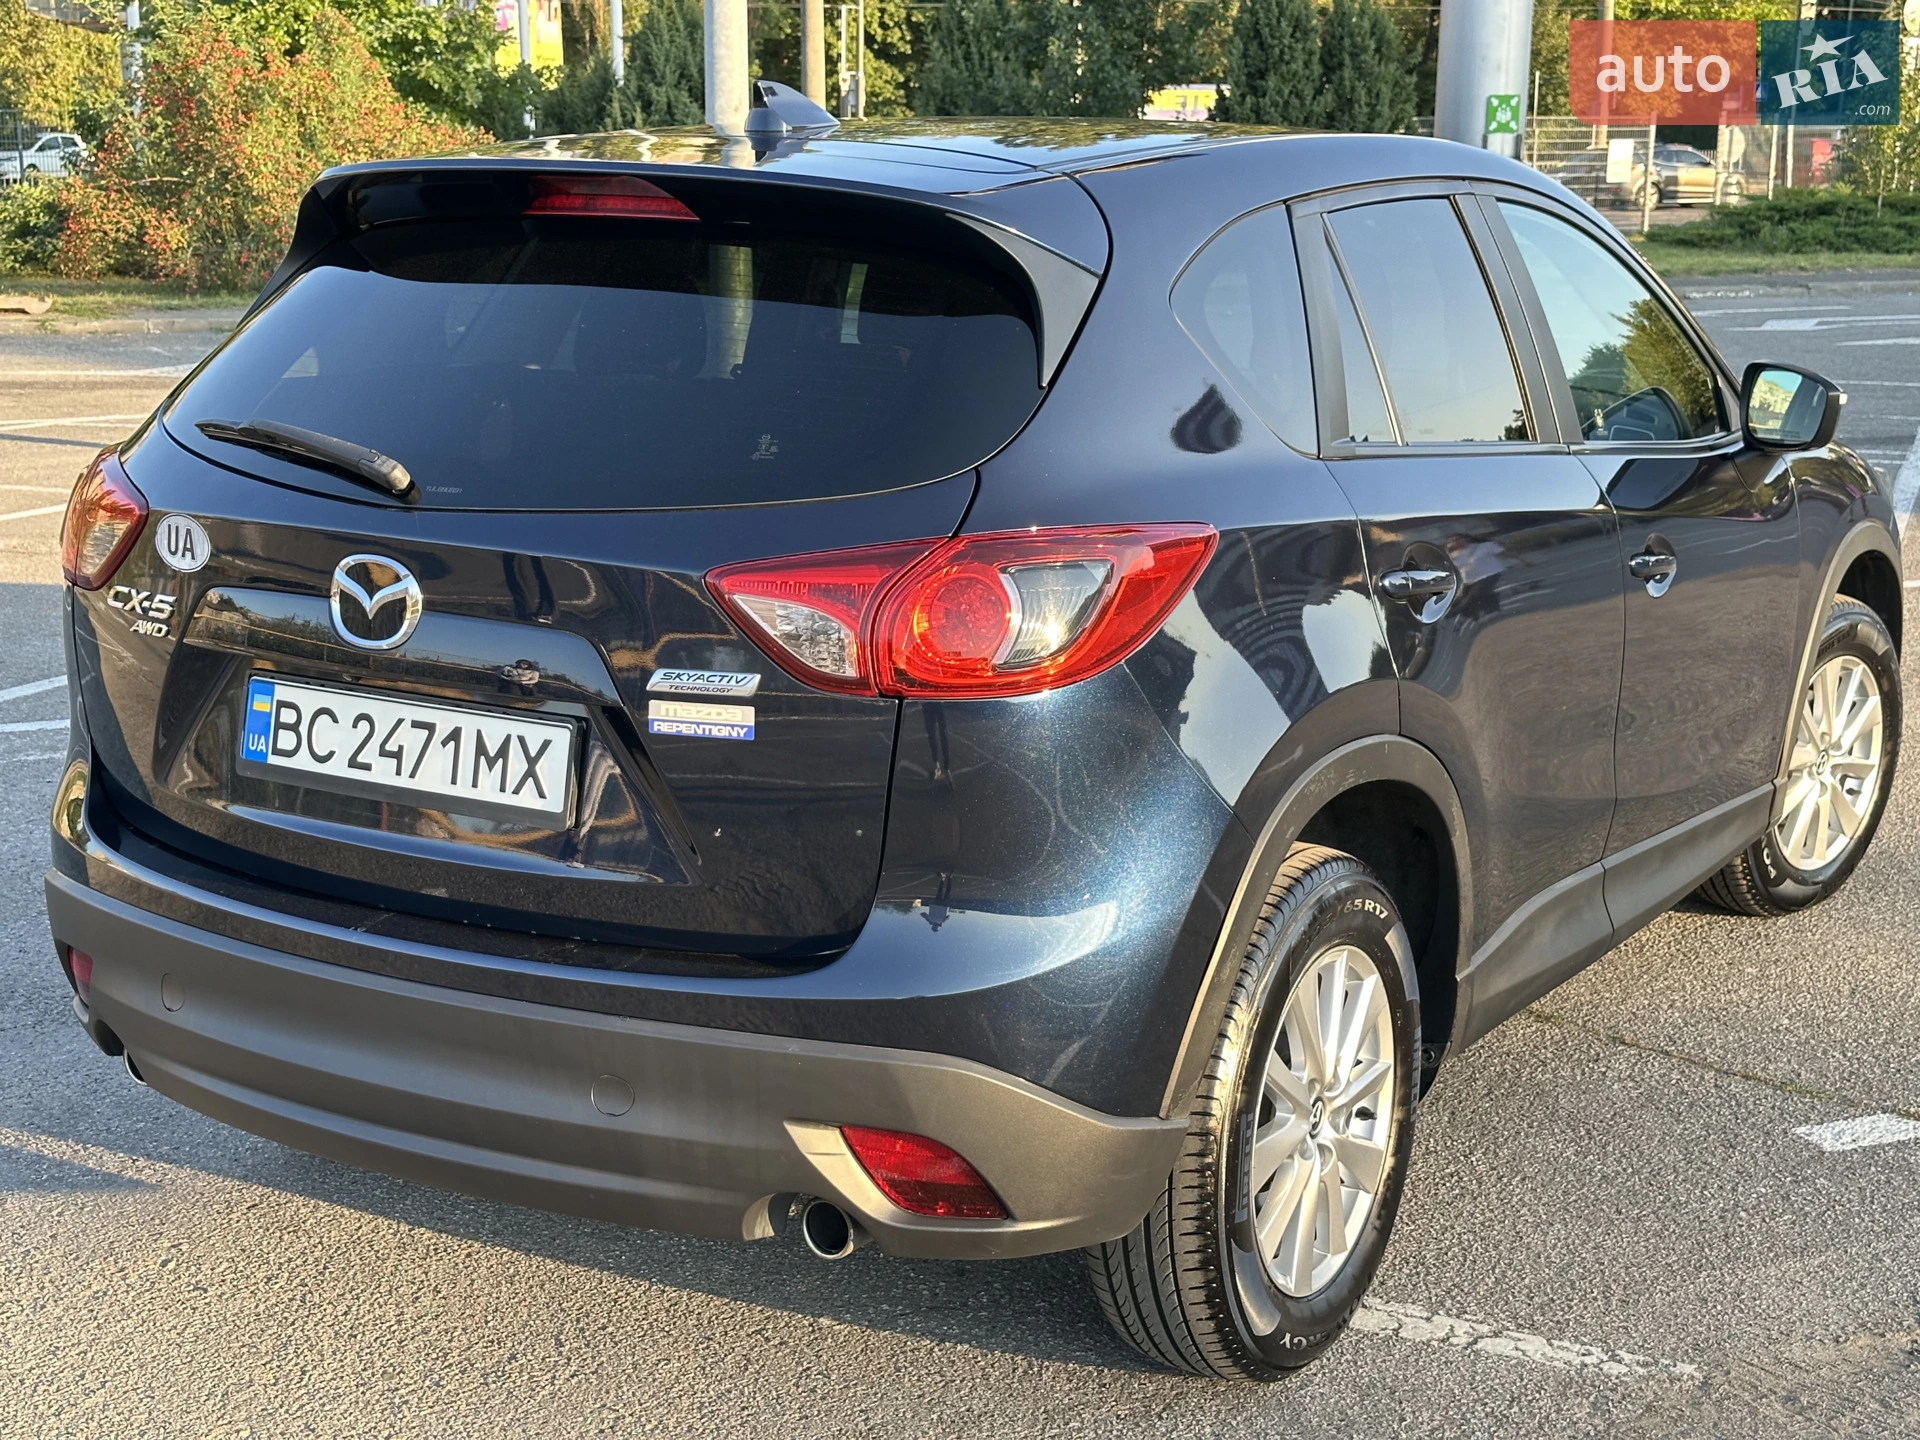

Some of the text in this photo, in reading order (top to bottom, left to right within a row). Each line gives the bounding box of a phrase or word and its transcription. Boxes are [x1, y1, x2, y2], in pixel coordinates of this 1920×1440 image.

[167, 523, 196, 561] UA
[107, 585, 178, 620] CX-5
[129, 619, 171, 638] AWD
[659, 671, 748, 684] SKYACTIV
[668, 684, 733, 693] TECHNOLOGY
[653, 722, 749, 738] REPENTIGNY
[248, 733, 267, 753] UA
[1234, 1112, 1254, 1224] PIRELLI
